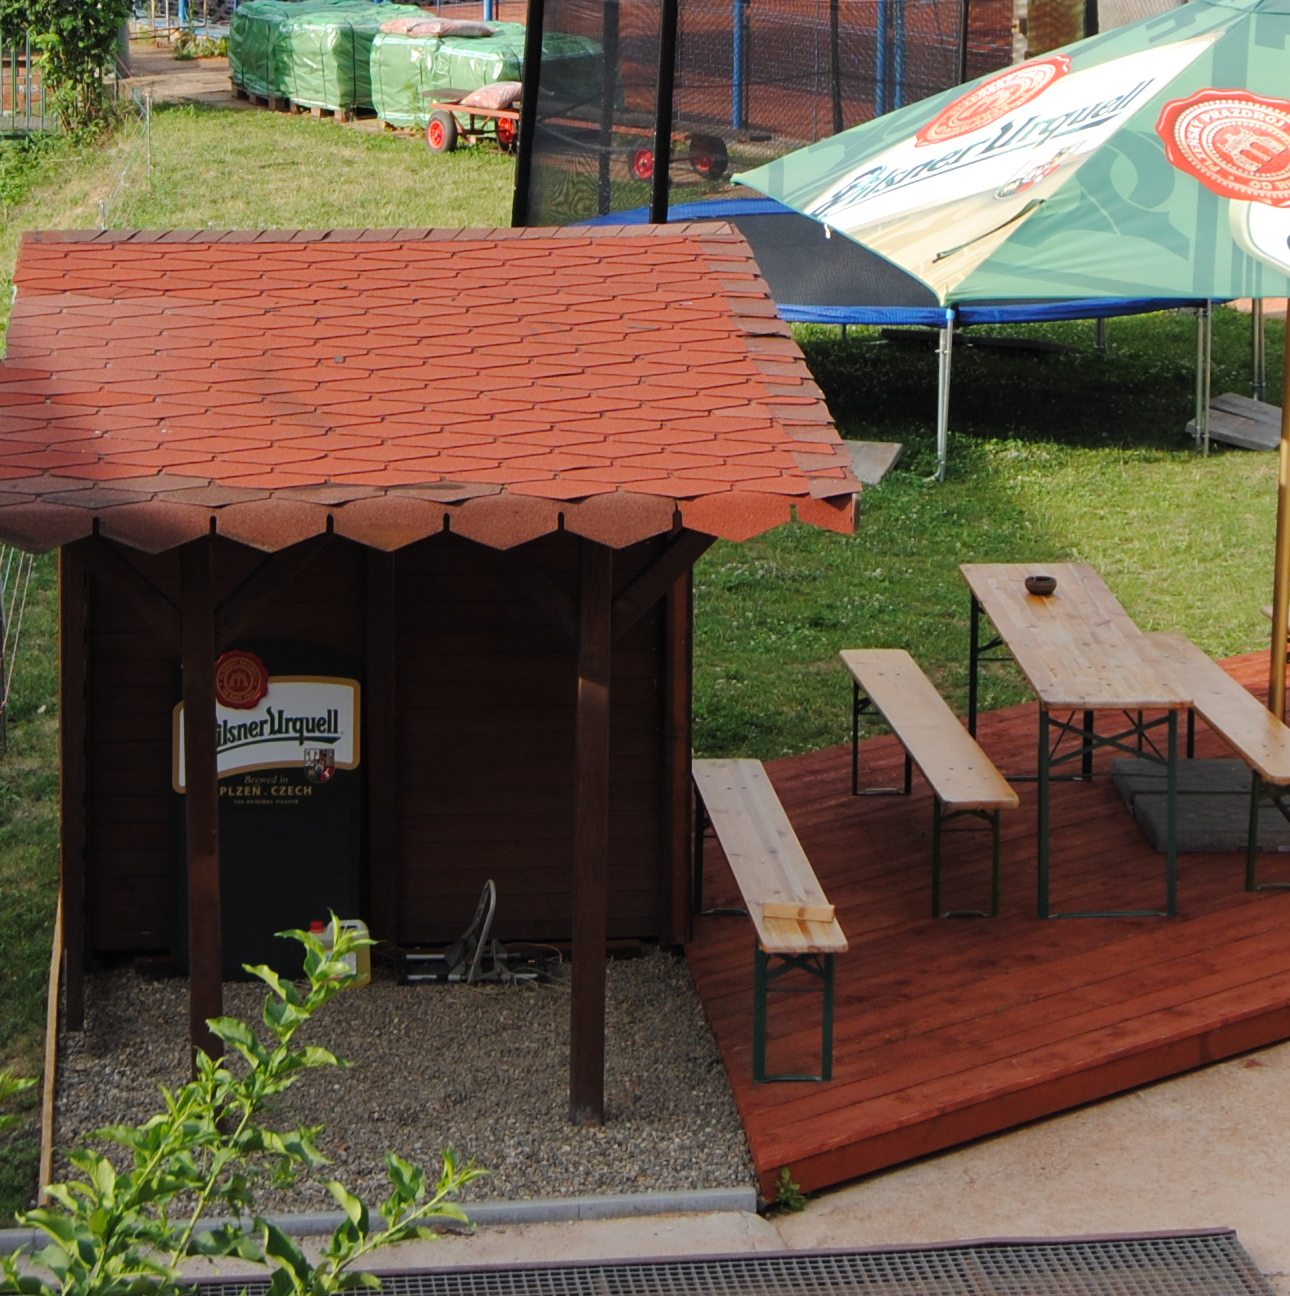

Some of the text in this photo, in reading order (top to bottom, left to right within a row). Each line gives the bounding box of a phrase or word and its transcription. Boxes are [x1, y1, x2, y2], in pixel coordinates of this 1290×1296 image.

[977, 77, 1157, 156] Urquell
[1203, 107, 1286, 128] PRAZDROJ
[1249, 180, 1273, 191] OD
[216, 705, 339, 747] ilsner Urquell
[244, 774, 289, 785] Brewed in
[270, 785, 313, 796] CZECH
